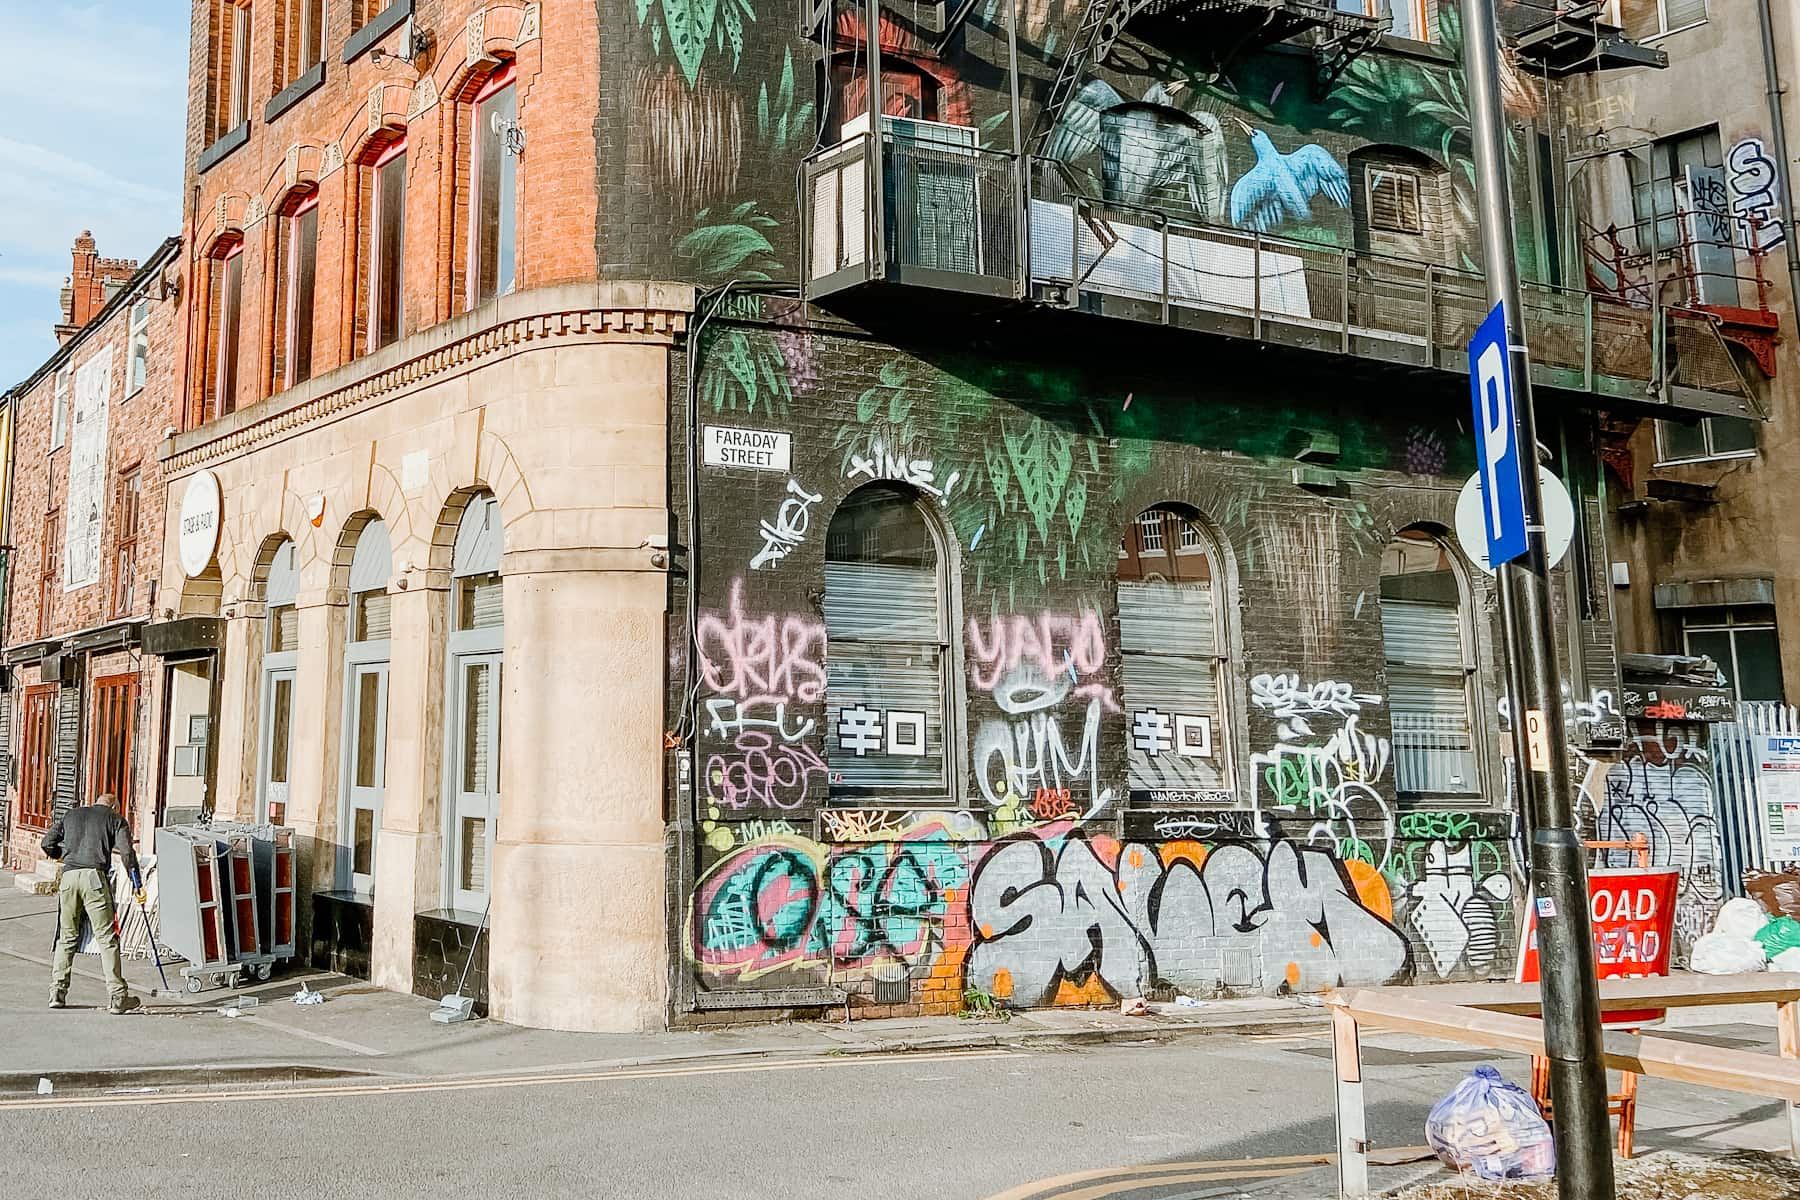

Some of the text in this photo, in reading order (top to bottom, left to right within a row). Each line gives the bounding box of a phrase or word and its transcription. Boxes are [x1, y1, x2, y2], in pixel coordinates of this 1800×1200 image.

[715, 429, 779, 450] FARADAY
[1477, 341, 1508, 540] P
[720, 448, 774, 467] STREET
[1591, 888, 1657, 921] OAD
